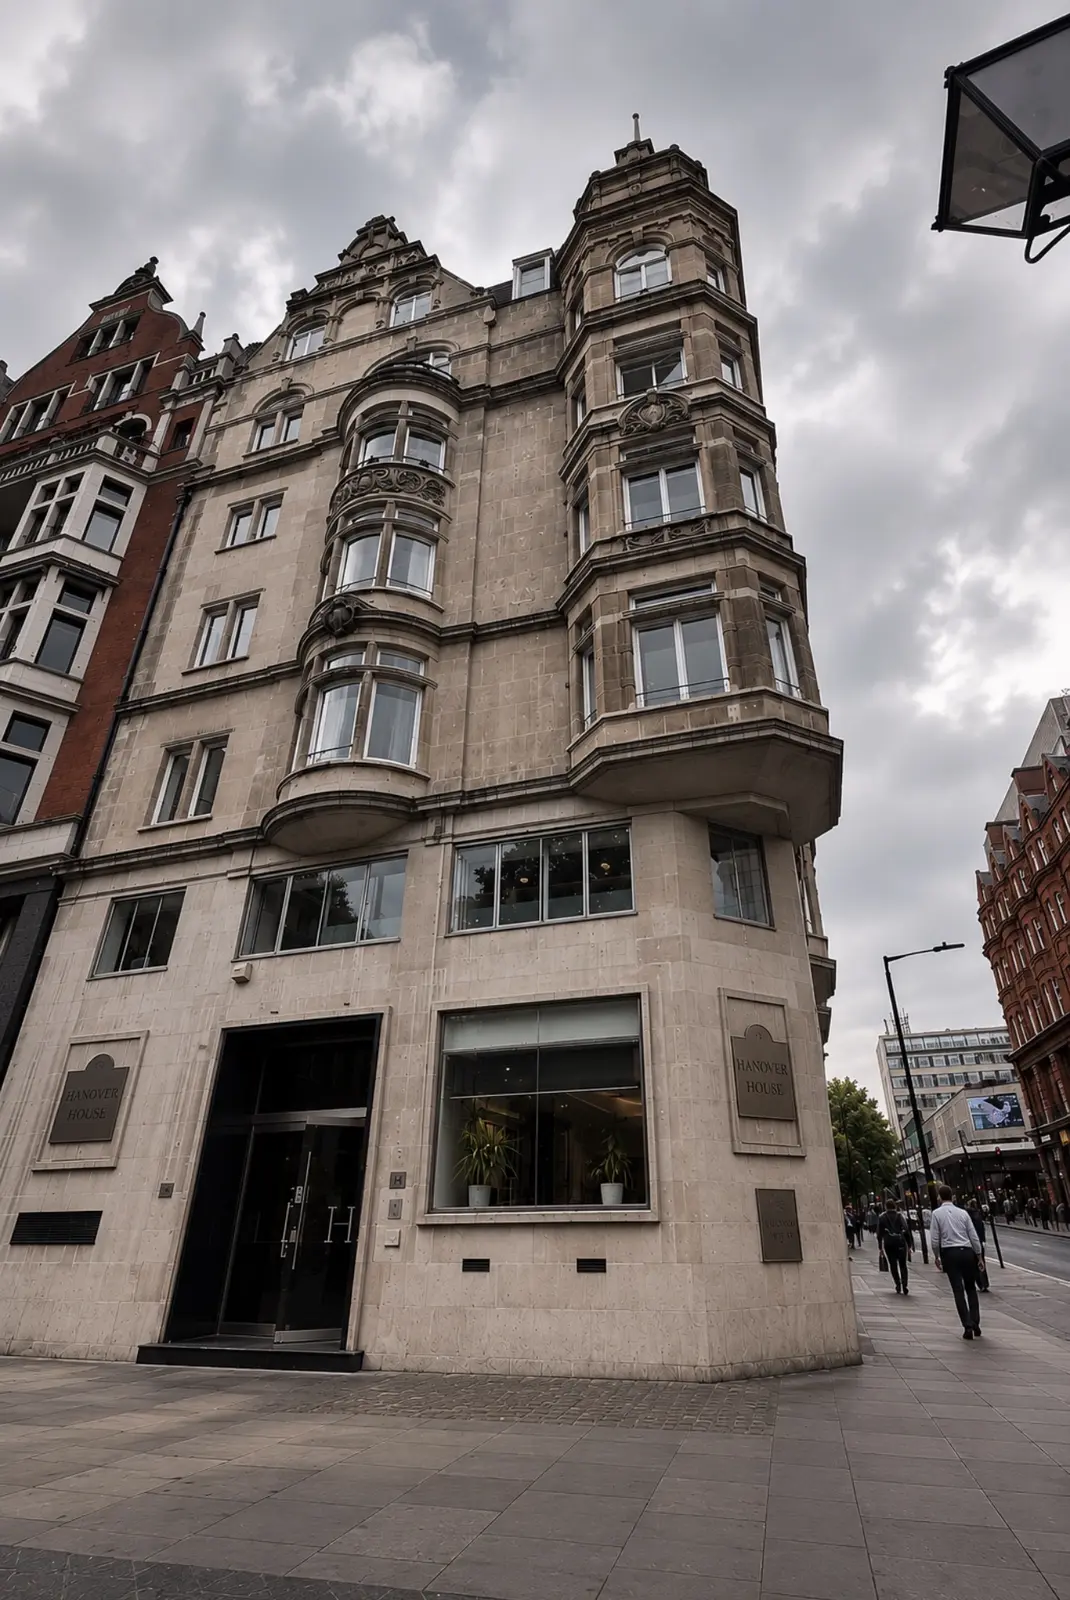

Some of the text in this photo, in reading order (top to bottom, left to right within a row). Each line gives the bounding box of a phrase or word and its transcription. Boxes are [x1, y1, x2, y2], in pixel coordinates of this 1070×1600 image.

[737, 1059, 788, 1076] HANOVER
[67, 1088, 119, 1102] HANOVER
[746, 1081, 784, 1096] HOUSE
[67, 1108, 107, 1121] HOUSE
